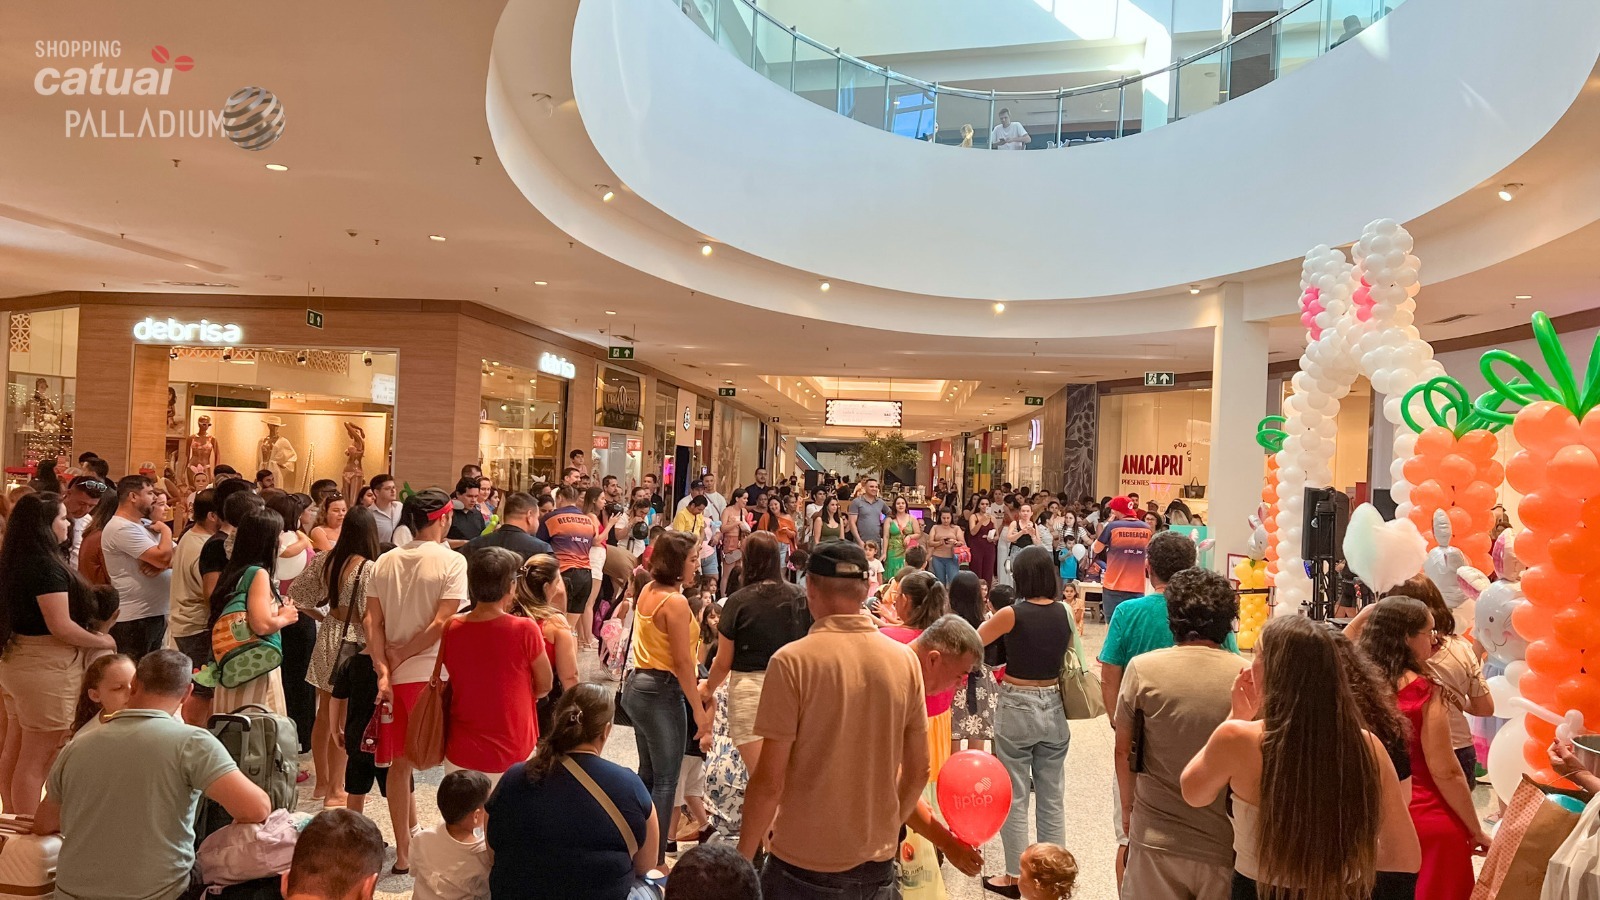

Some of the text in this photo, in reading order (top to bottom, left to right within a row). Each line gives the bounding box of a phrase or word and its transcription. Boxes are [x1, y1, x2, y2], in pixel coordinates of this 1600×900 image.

[133, 316, 242, 342] debrisa
[1121, 454, 1183, 476] ANACAPRI
[952, 793, 993, 810] tiptop
